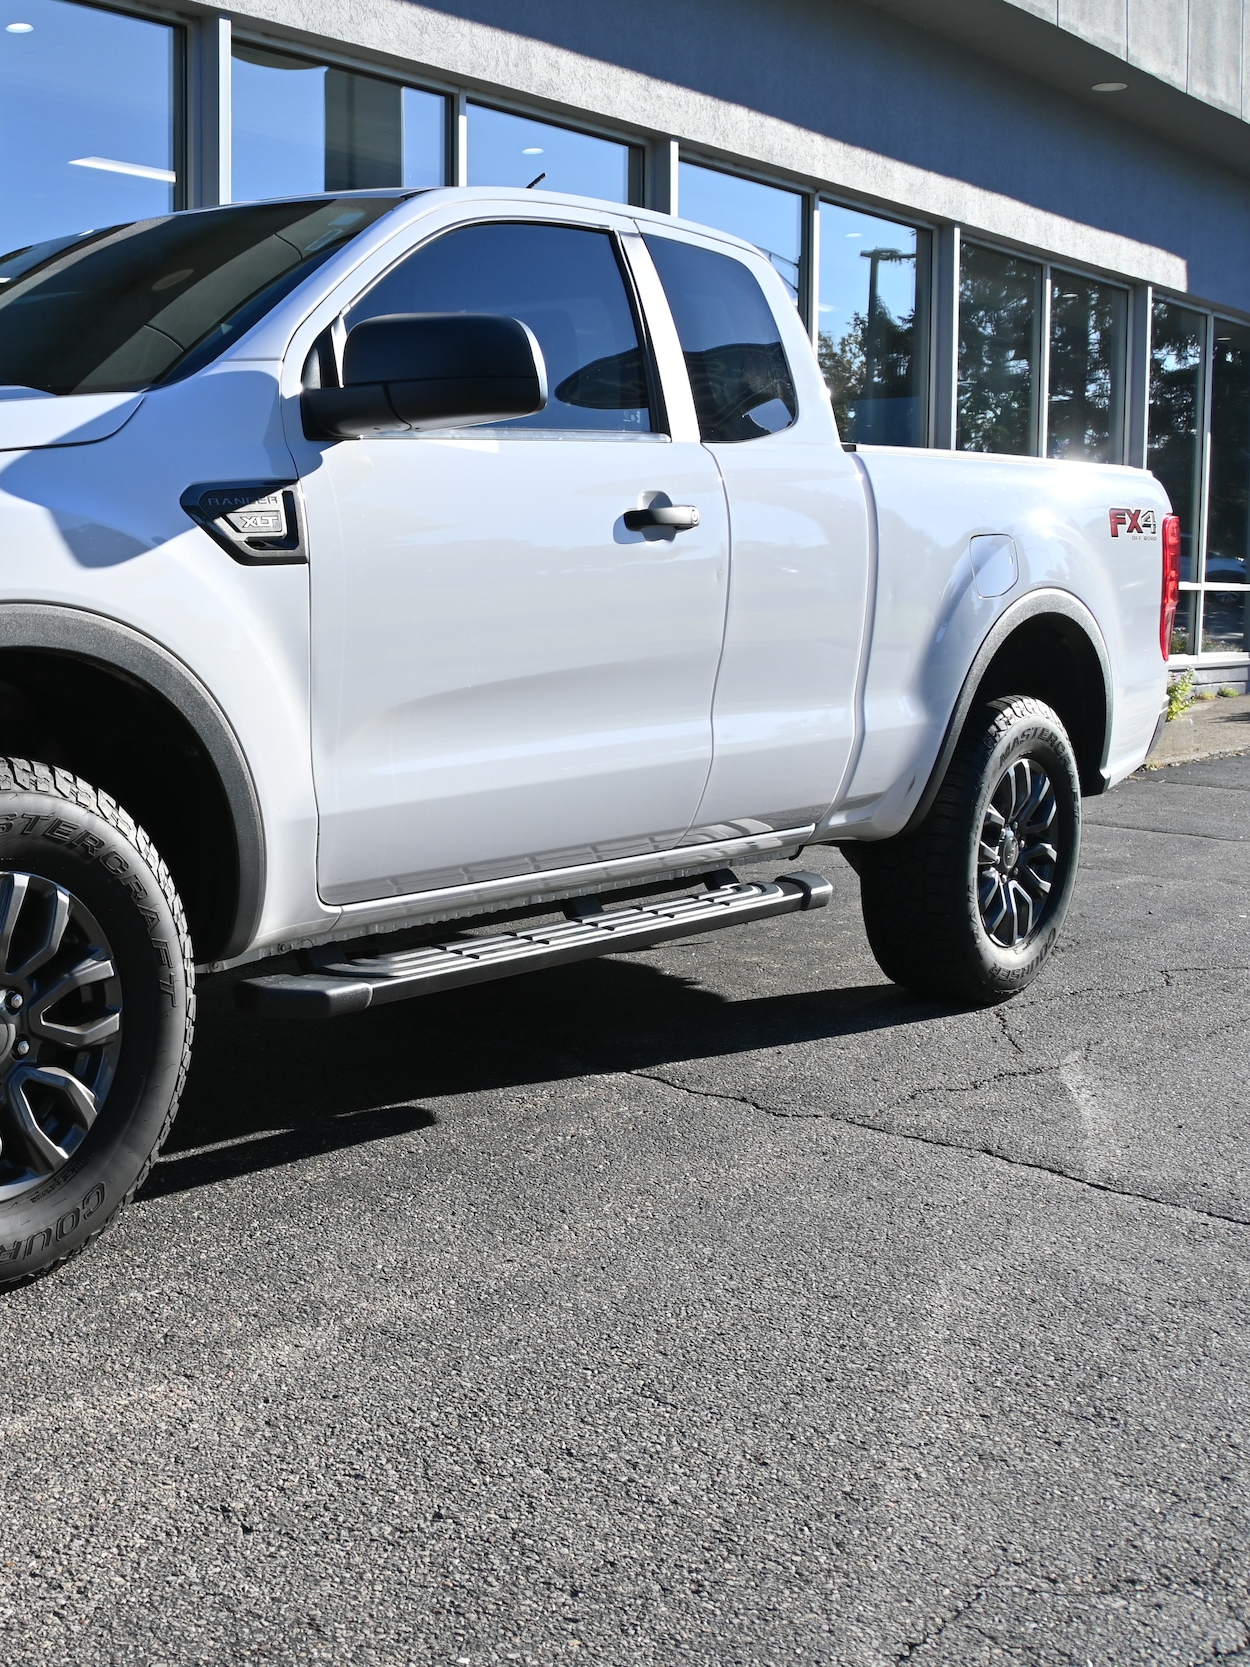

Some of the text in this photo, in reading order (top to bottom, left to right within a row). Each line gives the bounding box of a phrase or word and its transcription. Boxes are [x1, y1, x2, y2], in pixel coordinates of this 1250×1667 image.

[207, 496, 278, 506] RANGER
[240, 515, 279, 529] XLT
[1109, 507, 1156, 537] FX4
